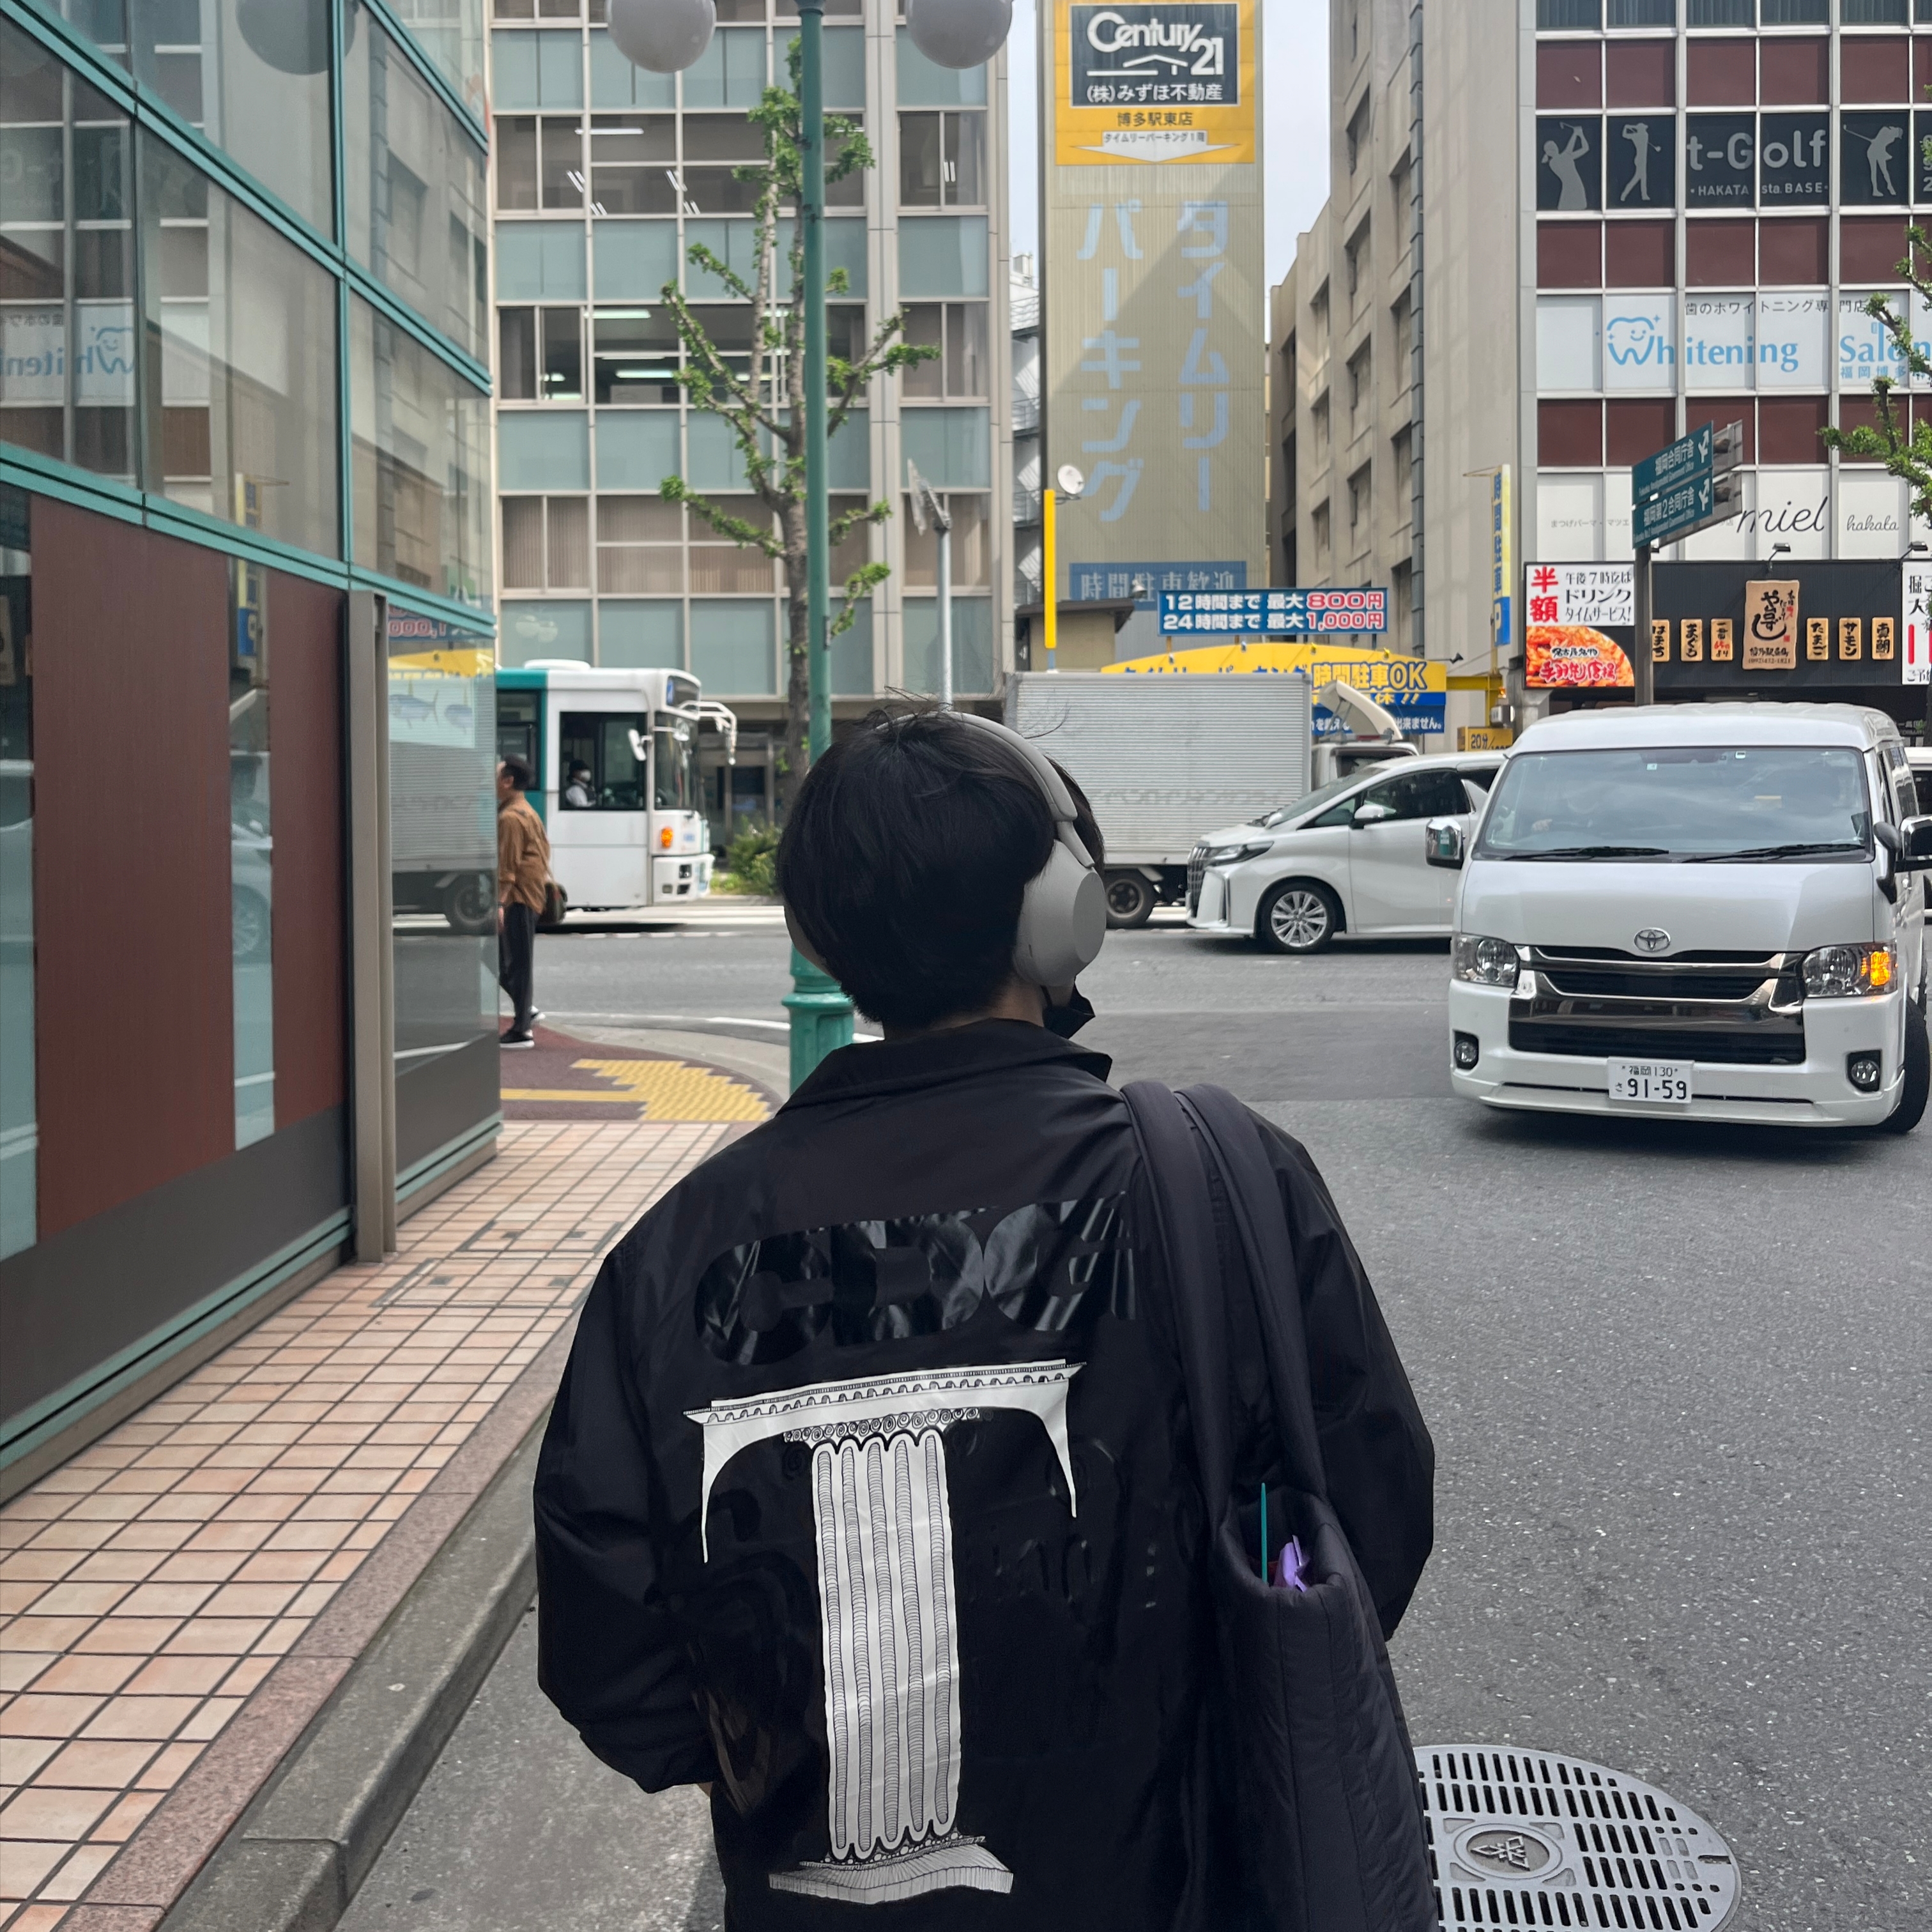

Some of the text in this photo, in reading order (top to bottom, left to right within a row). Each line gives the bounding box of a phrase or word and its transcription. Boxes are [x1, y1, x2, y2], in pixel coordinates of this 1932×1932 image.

[1087, 11, 1224, 75] Century 21
[1086, 83, 1223, 103] (株)みずほ不動産
[1117, 111, 1193, 127] 博多駅東店
[1687, 129, 1826, 171] t-Golf
[1077, 199, 1144, 522] パーキング
[1177, 201, 1230, 510] タイムリー
[1736, 496, 1899, 533] miel hakata
[1529, 565, 1559, 623] 半額
[1566, 589, 1631, 604] ドリンク
[1686, 623, 1699, 657] まぐろ
[1811, 622, 1827, 656] たまご
[1843, 622, 1857, 657] サーモン
[1312, 659, 1428, 690] 時間駐車OK
[1629, 1065, 1673, 1077] 福岡 130
[1627, 1078, 1687, 1100] 91-59
